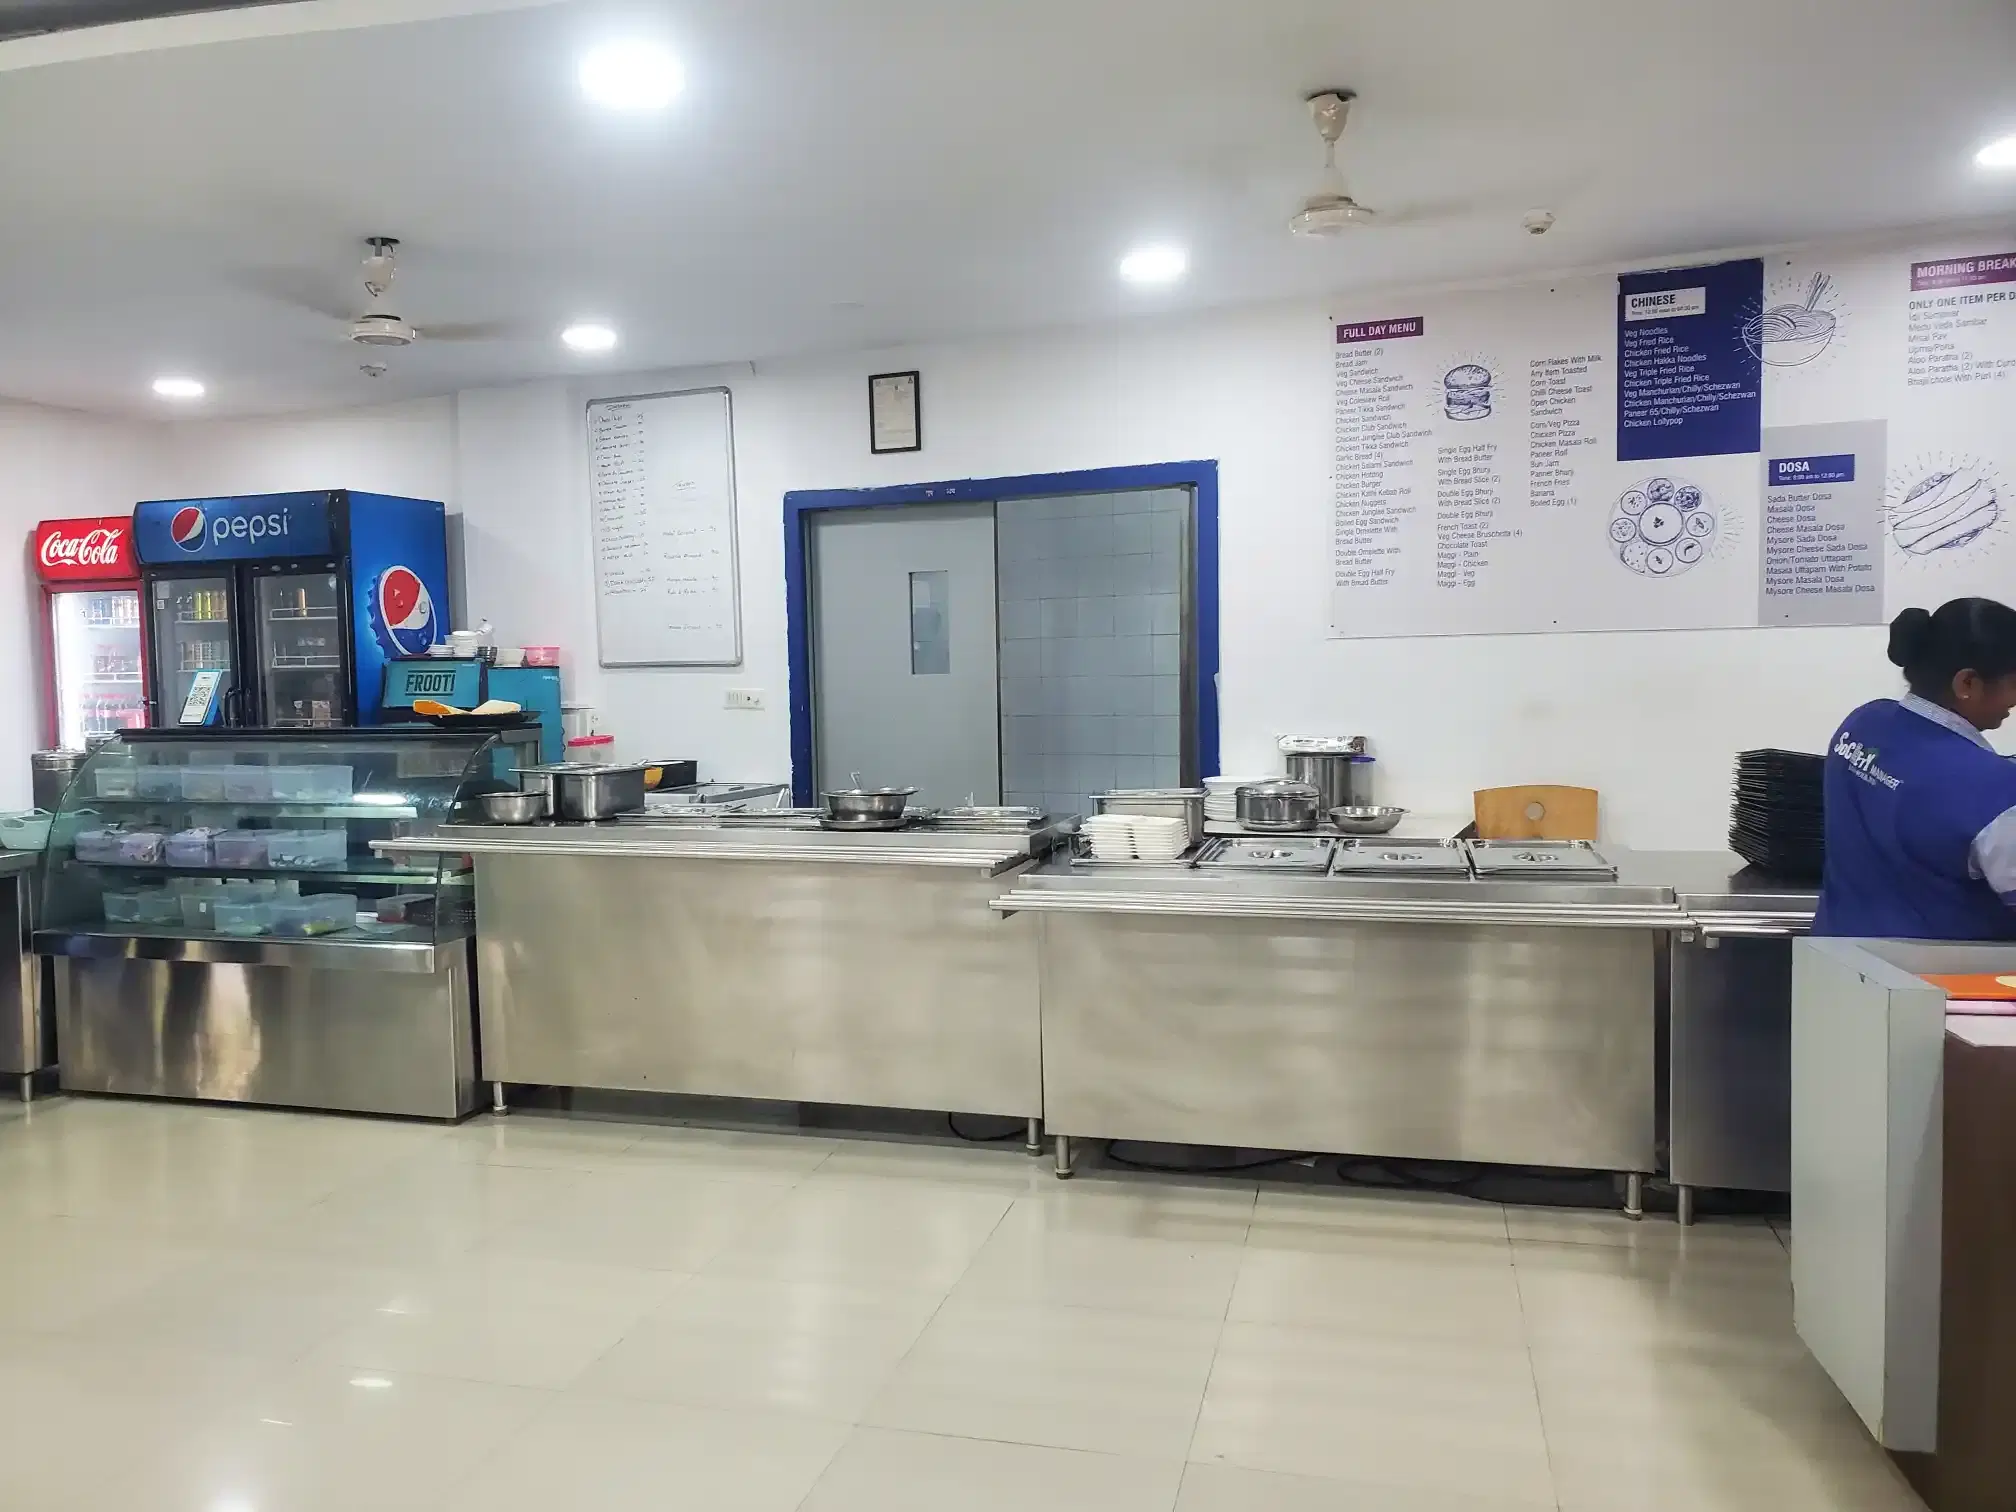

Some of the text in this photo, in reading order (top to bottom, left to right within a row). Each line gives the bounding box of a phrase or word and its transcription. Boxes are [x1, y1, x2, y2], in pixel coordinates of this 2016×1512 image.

[1917, 262, 1974, 277] MORNING
[1631, 294, 1676, 308] CHINESE
[1909, 300, 1934, 309] ONLY
[1937, 298, 1956, 307] ONE
[1960, 295, 1983, 304] ITEM
[1987, 293, 2006, 302] PER
[1344, 322, 1416, 338] FULL DAY MENU
[1639, 328, 1668, 336] Noodles
[1625, 349, 1652, 357] Chicken
[1624, 359, 1652, 367] Chicken
[1678, 354, 1707, 363] Noodles
[1639, 368, 1658, 377] Triple
[1624, 379, 1652, 387] Chicken
[1654, 377, 1673, 386] Triple
[1438, 447, 1457, 455] Single
[1459, 446, 1471, 454] Egg
[1487, 444, 1497, 452] Fry
[1779, 461, 1809, 472] DOSA
[1461, 489, 1474, 498] Egg
[1767, 505, 1793, 513] Masala
[213, 508, 288, 545] pepsi
[1356, 518, 1368, 527] Egg
[1796, 524, 1823, 532] Masala
[1767, 537, 1794, 546] Mysore
[41, 528, 124, 566] Coca-Cola
[1767, 547, 1794, 556] Mysore
[1358, 570, 1370, 578] Egg
[1766, 578, 1793, 586] Mysore
[1766, 588, 1794, 596] Mysore
[406, 674, 456, 691] FROOTI
